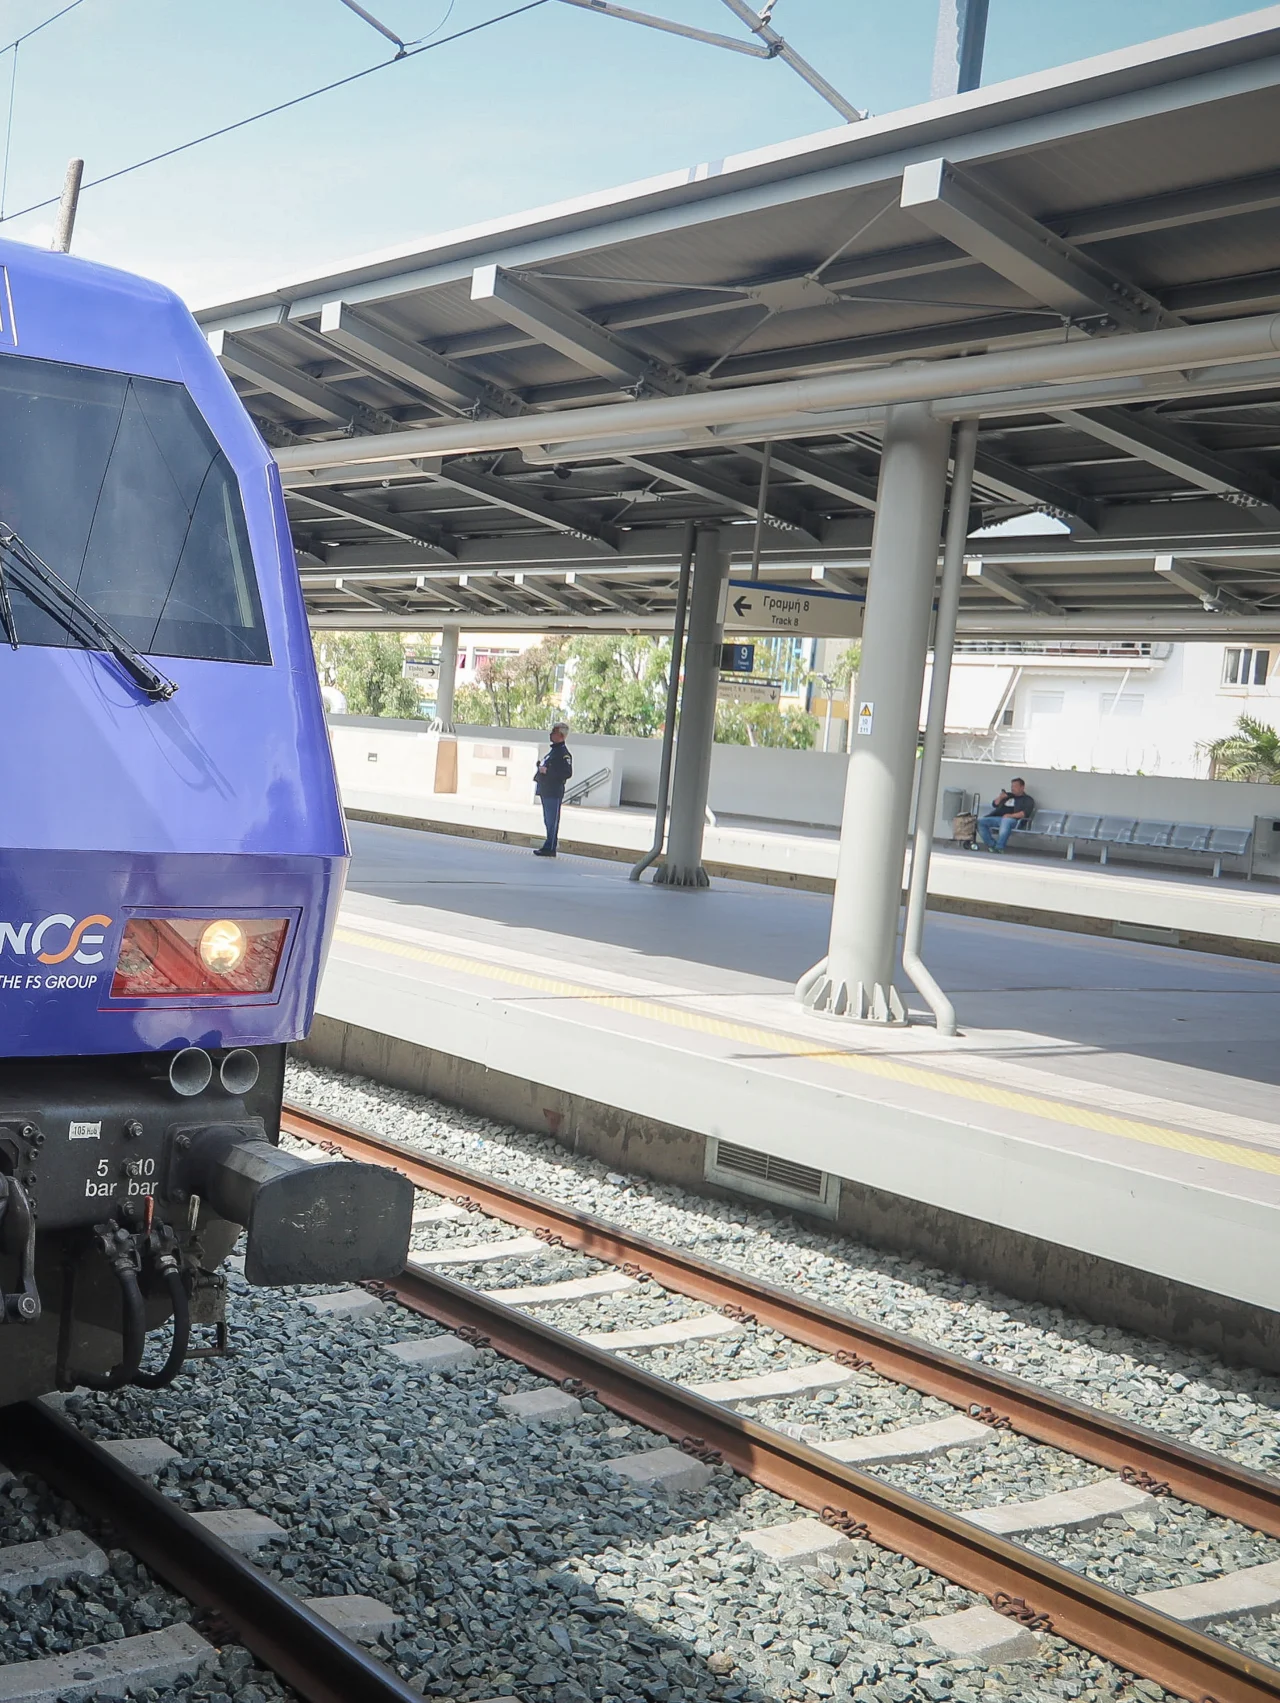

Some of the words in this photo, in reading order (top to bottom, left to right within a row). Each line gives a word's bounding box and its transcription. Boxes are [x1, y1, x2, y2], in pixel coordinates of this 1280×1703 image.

[763, 595, 801, 614] Γραμμή
[803, 600, 810, 612] 8
[772, 614, 792, 626] Track
[793, 617, 799, 627] 8
[740, 646, 748, 660] 9
[25, 975, 42, 989] FS
[45, 975, 98, 989] GROUP
[96, 1159, 109, 1177] 5
[136, 1158, 155, 1176] 10
[85, 1179, 118, 1197] bar
[127, 1178, 159, 1196] bar
